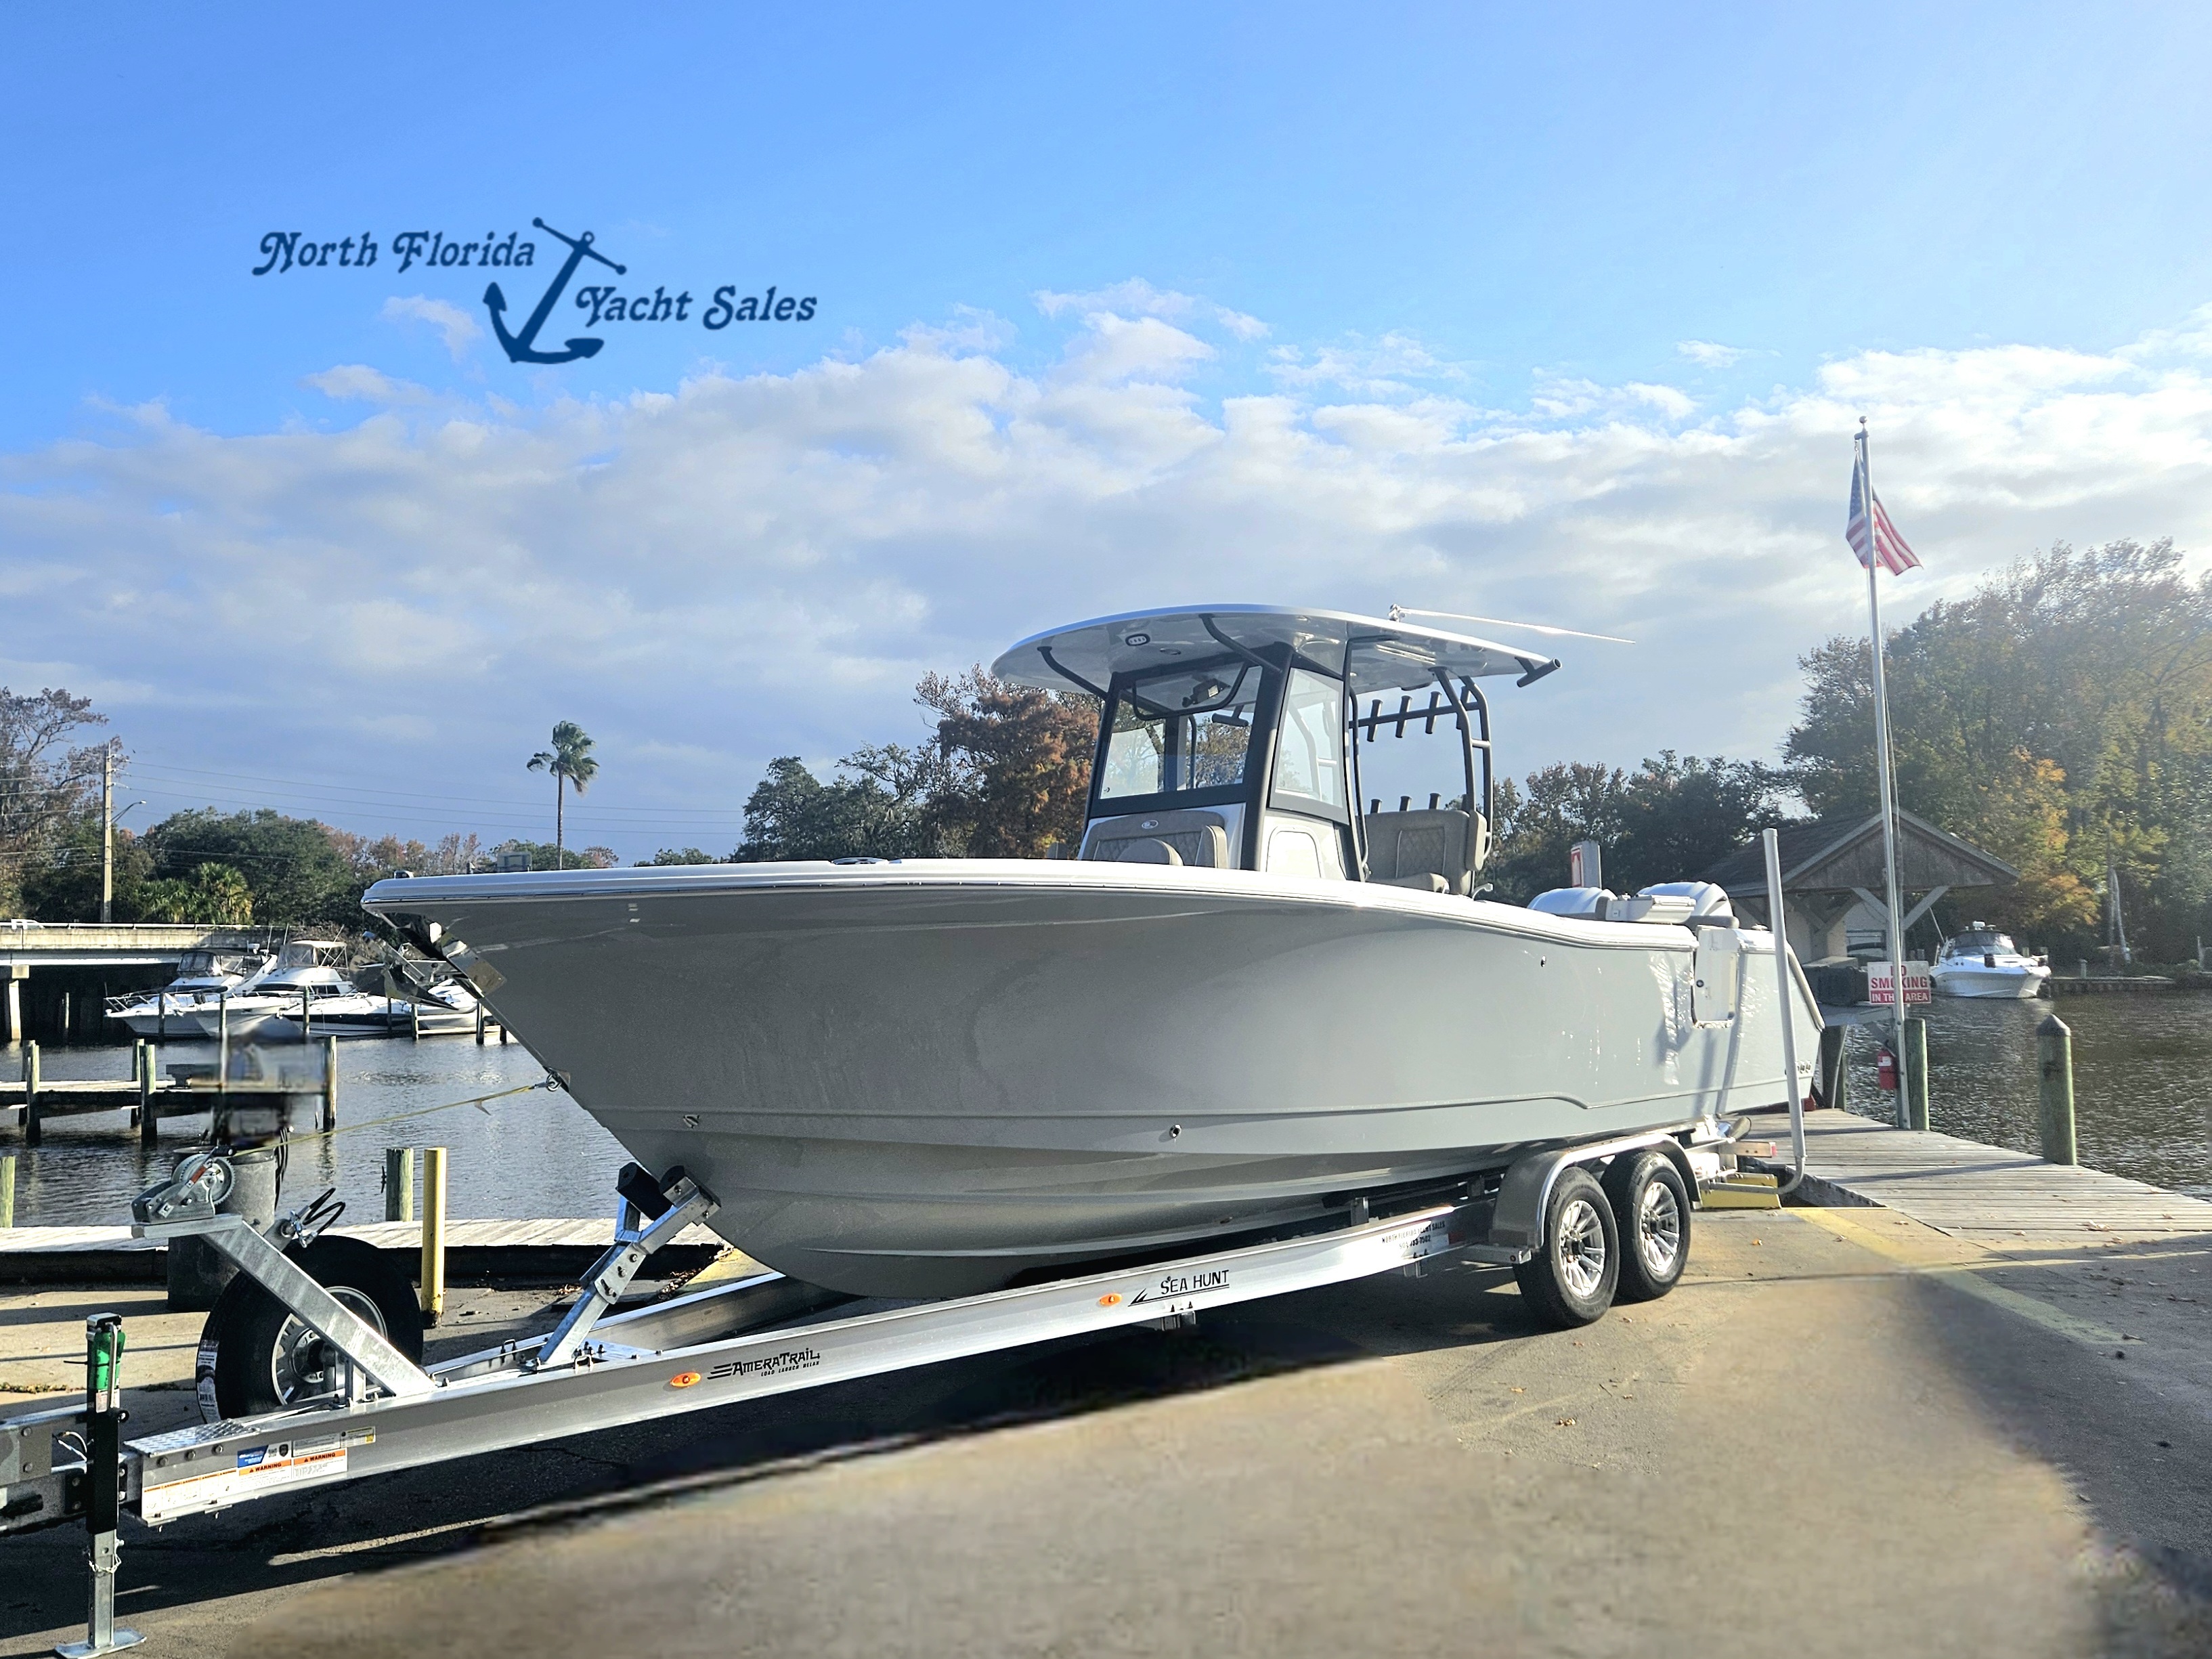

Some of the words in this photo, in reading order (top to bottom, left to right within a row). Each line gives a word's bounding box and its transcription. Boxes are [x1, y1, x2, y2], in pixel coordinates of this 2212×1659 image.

[1872, 993, 1881, 1002] IN
[1905, 992, 1928, 1001] AREA
[1161, 1276, 1188, 1295] SEA
[1194, 1270, 1229, 1289] HUNT
[309, 1452, 336, 1462] WARNING
[255, 1462, 282, 1472] WARNING
